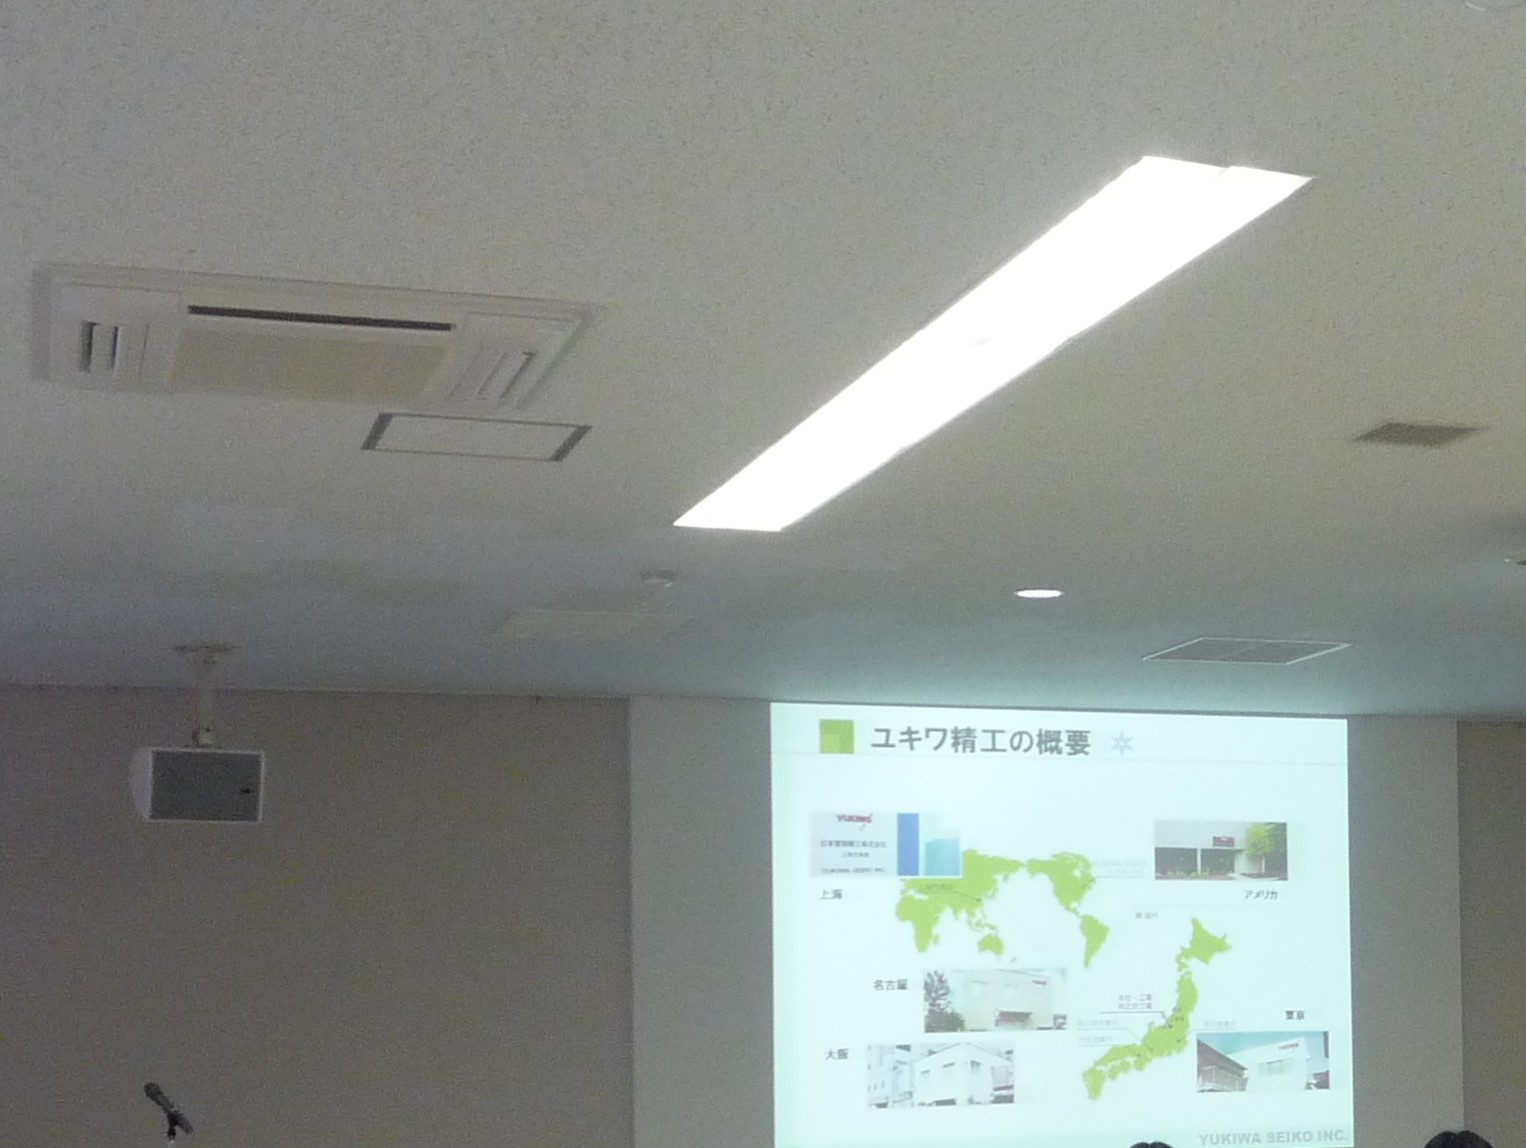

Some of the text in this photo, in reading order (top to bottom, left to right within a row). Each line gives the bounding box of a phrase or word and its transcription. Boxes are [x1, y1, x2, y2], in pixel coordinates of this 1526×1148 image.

[871, 726, 1091, 755] ユキワ精工の概要
[820, 889, 842, 899] 上海
[1244, 889, 1278, 900] アメリカ
[873, 979, 908, 991] 名古屋
[1285, 1010, 1305, 1020] 東京
[825, 1048, 849, 1060] 大阪
[1199, 1130, 1348, 1145] YUKIWA SEIKO INC.
